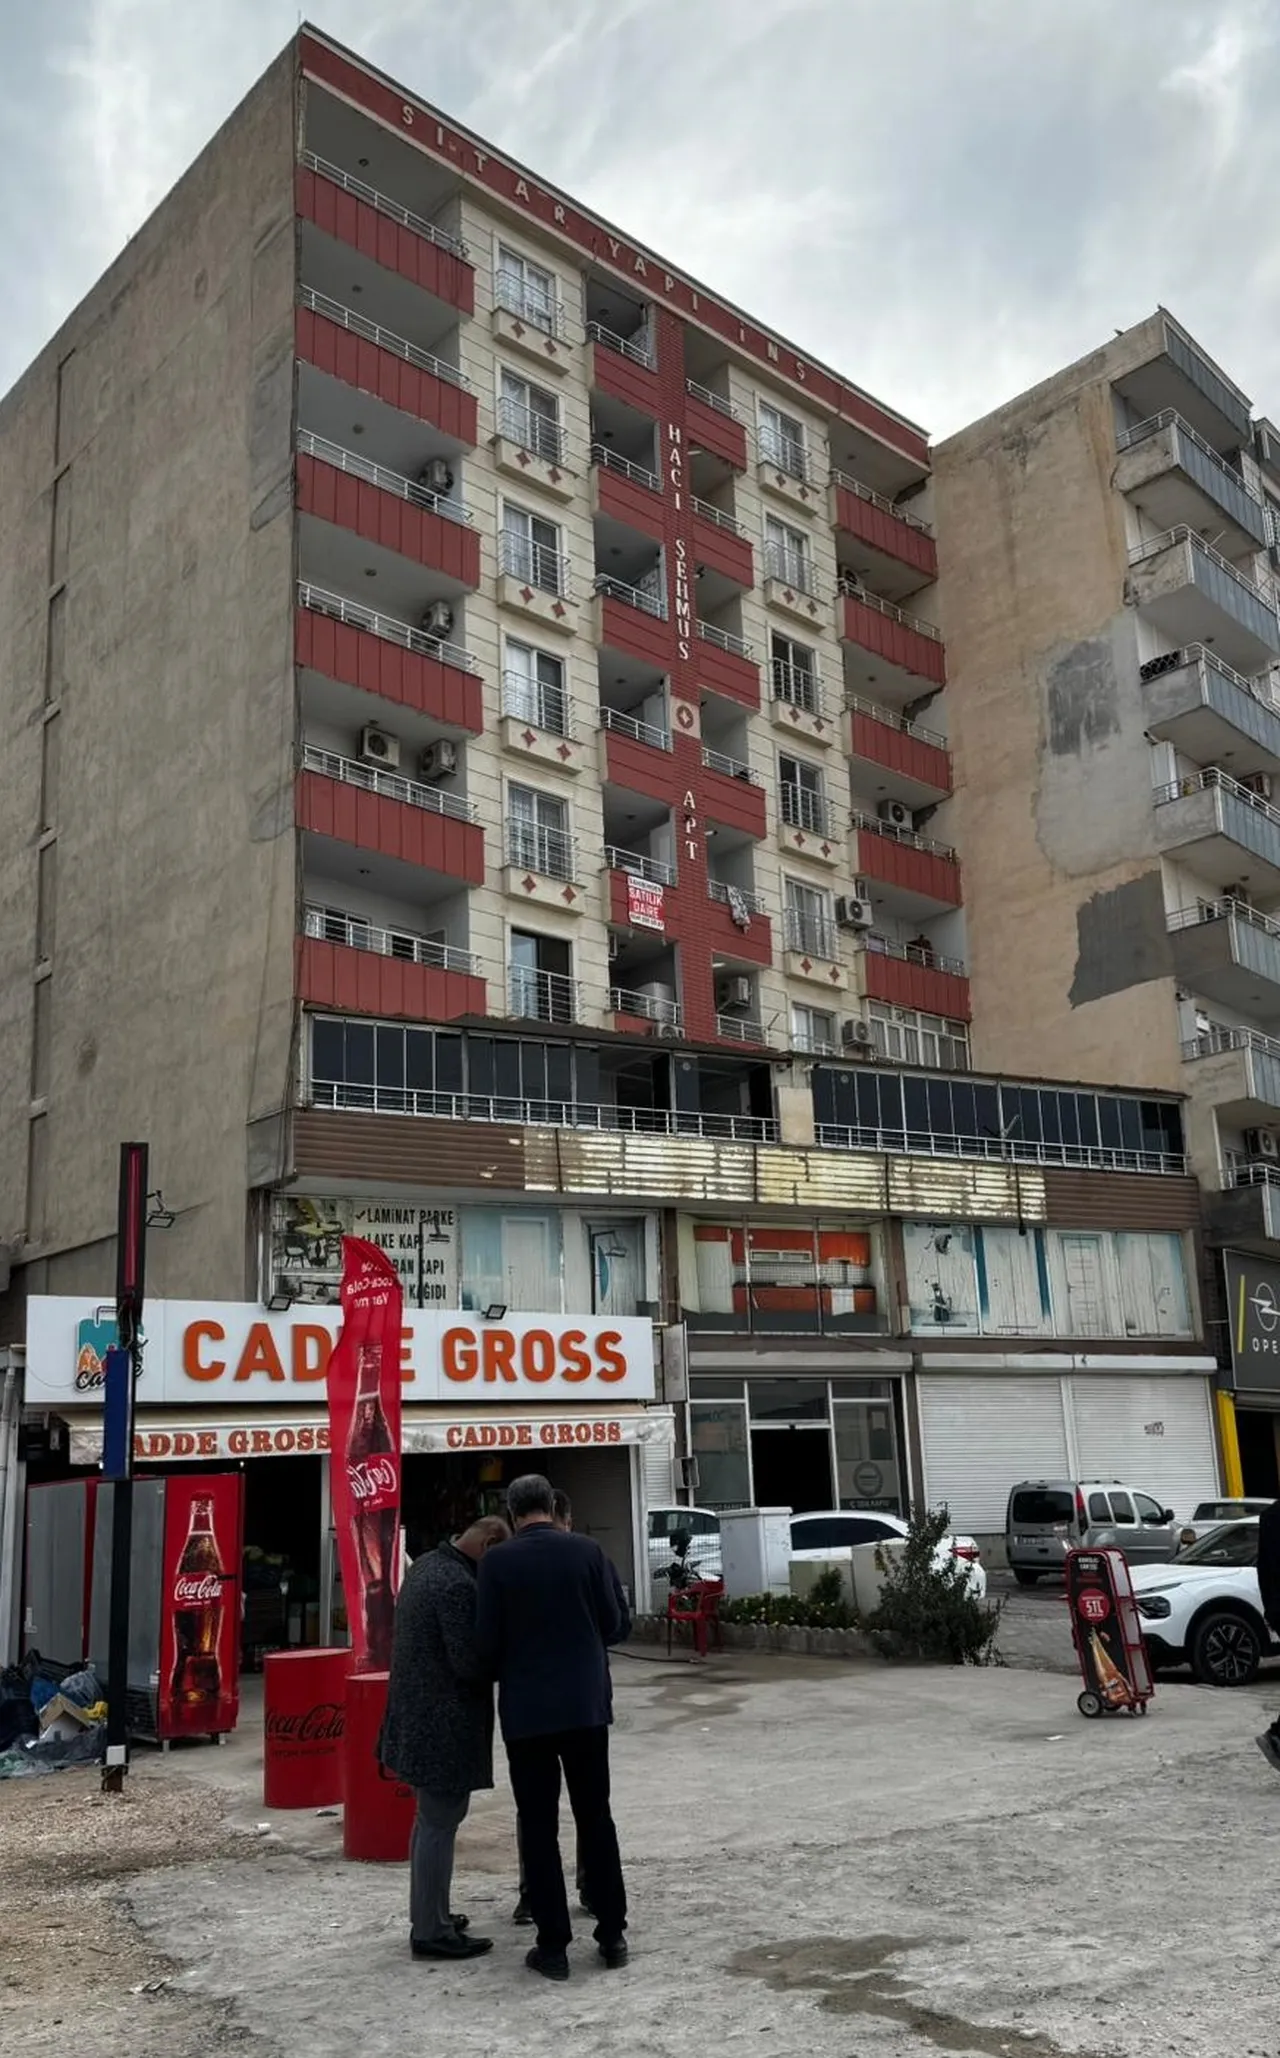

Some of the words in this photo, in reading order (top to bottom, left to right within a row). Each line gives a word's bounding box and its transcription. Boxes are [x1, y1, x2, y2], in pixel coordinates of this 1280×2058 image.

[608, 237, 699, 312] YAPI
[668, 424, 682, 511] HACI
[683, 790, 698, 860] APT
[628, 887, 663, 906] SATILIK
[399, 1234, 422, 1249] KAP
[183, 1320, 416, 1383] CADE
[442, 1327, 628, 1383] GROSS
[1251, 1336, 1280, 1355] OPE
[133, 1431, 218, 1458] ADDE
[228, 1427, 332, 1453] GROSS
[446, 1425, 532, 1449] CADDE
[540, 1421, 622, 1444] GROSS
